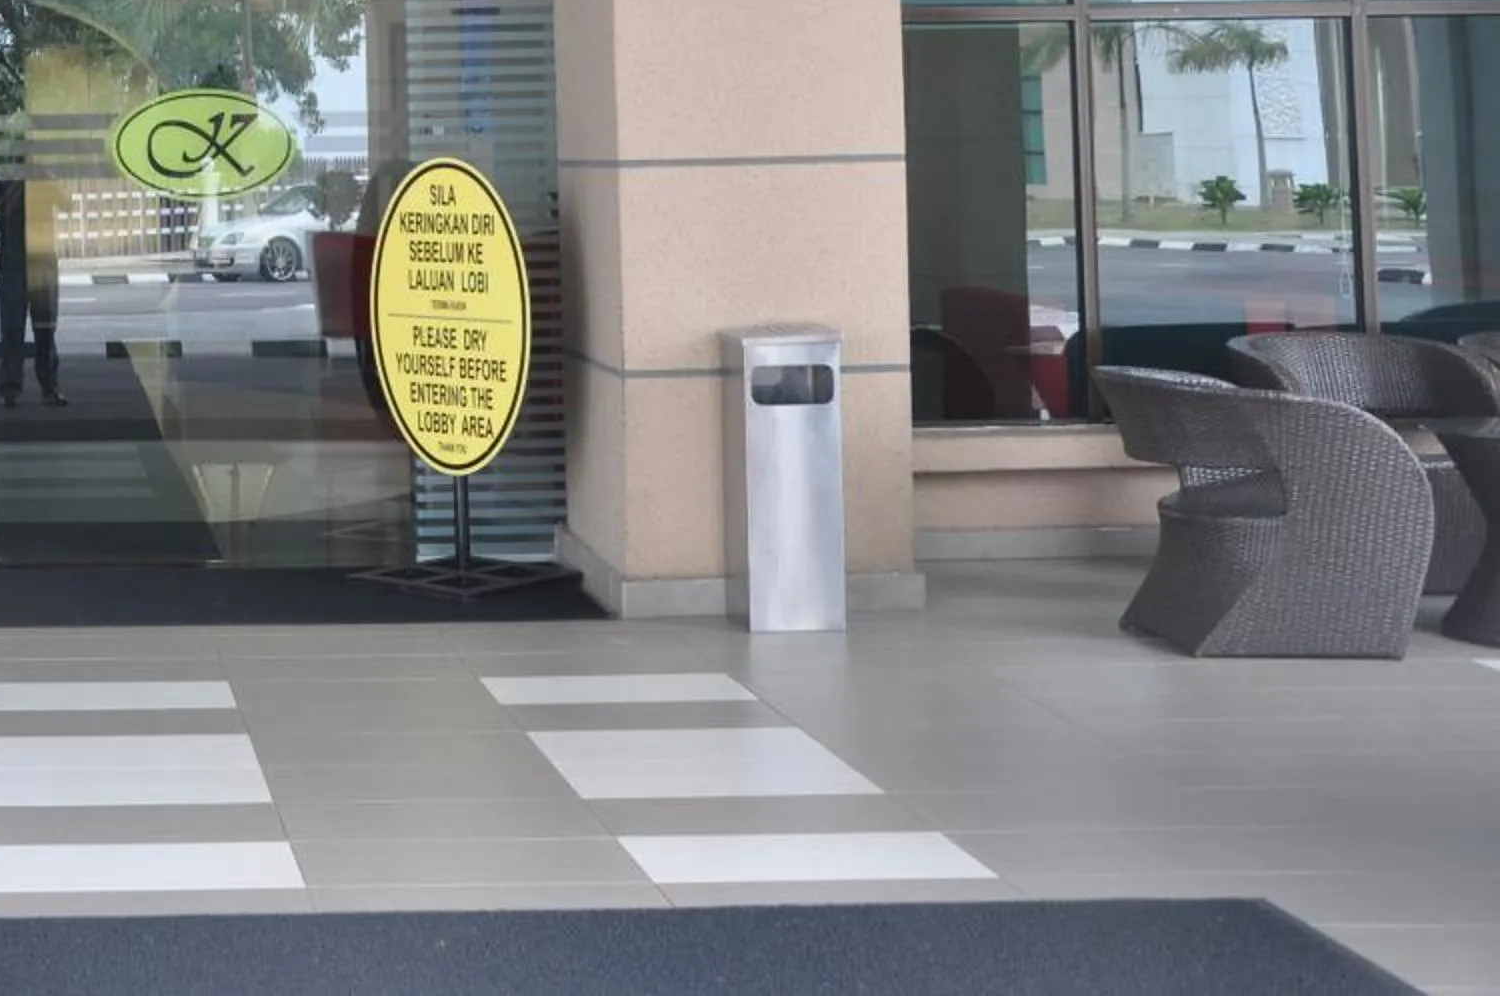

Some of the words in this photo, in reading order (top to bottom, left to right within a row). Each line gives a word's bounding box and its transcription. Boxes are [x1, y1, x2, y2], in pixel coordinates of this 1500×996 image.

[430, 184, 456, 207] SILA
[399, 211, 469, 235] KERINGKAN
[471, 213, 495, 236] DIRI
[409, 240, 465, 263] SEBELUM
[467, 243, 484, 265] KE
[408, 269, 455, 292] LALUAN
[461, 271, 489, 293] LOBI
[412, 325, 458, 349] PLEASE
[463, 329, 487, 351] DRY
[395, 352, 456, 378] YOURSELF
[459, 357, 507, 382] BEFORE
[410, 382, 468, 408] ENTERING
[470, 387, 494, 410] THE
[417, 410, 457, 435] LOBBY
[461, 415, 494, 439] AREA
